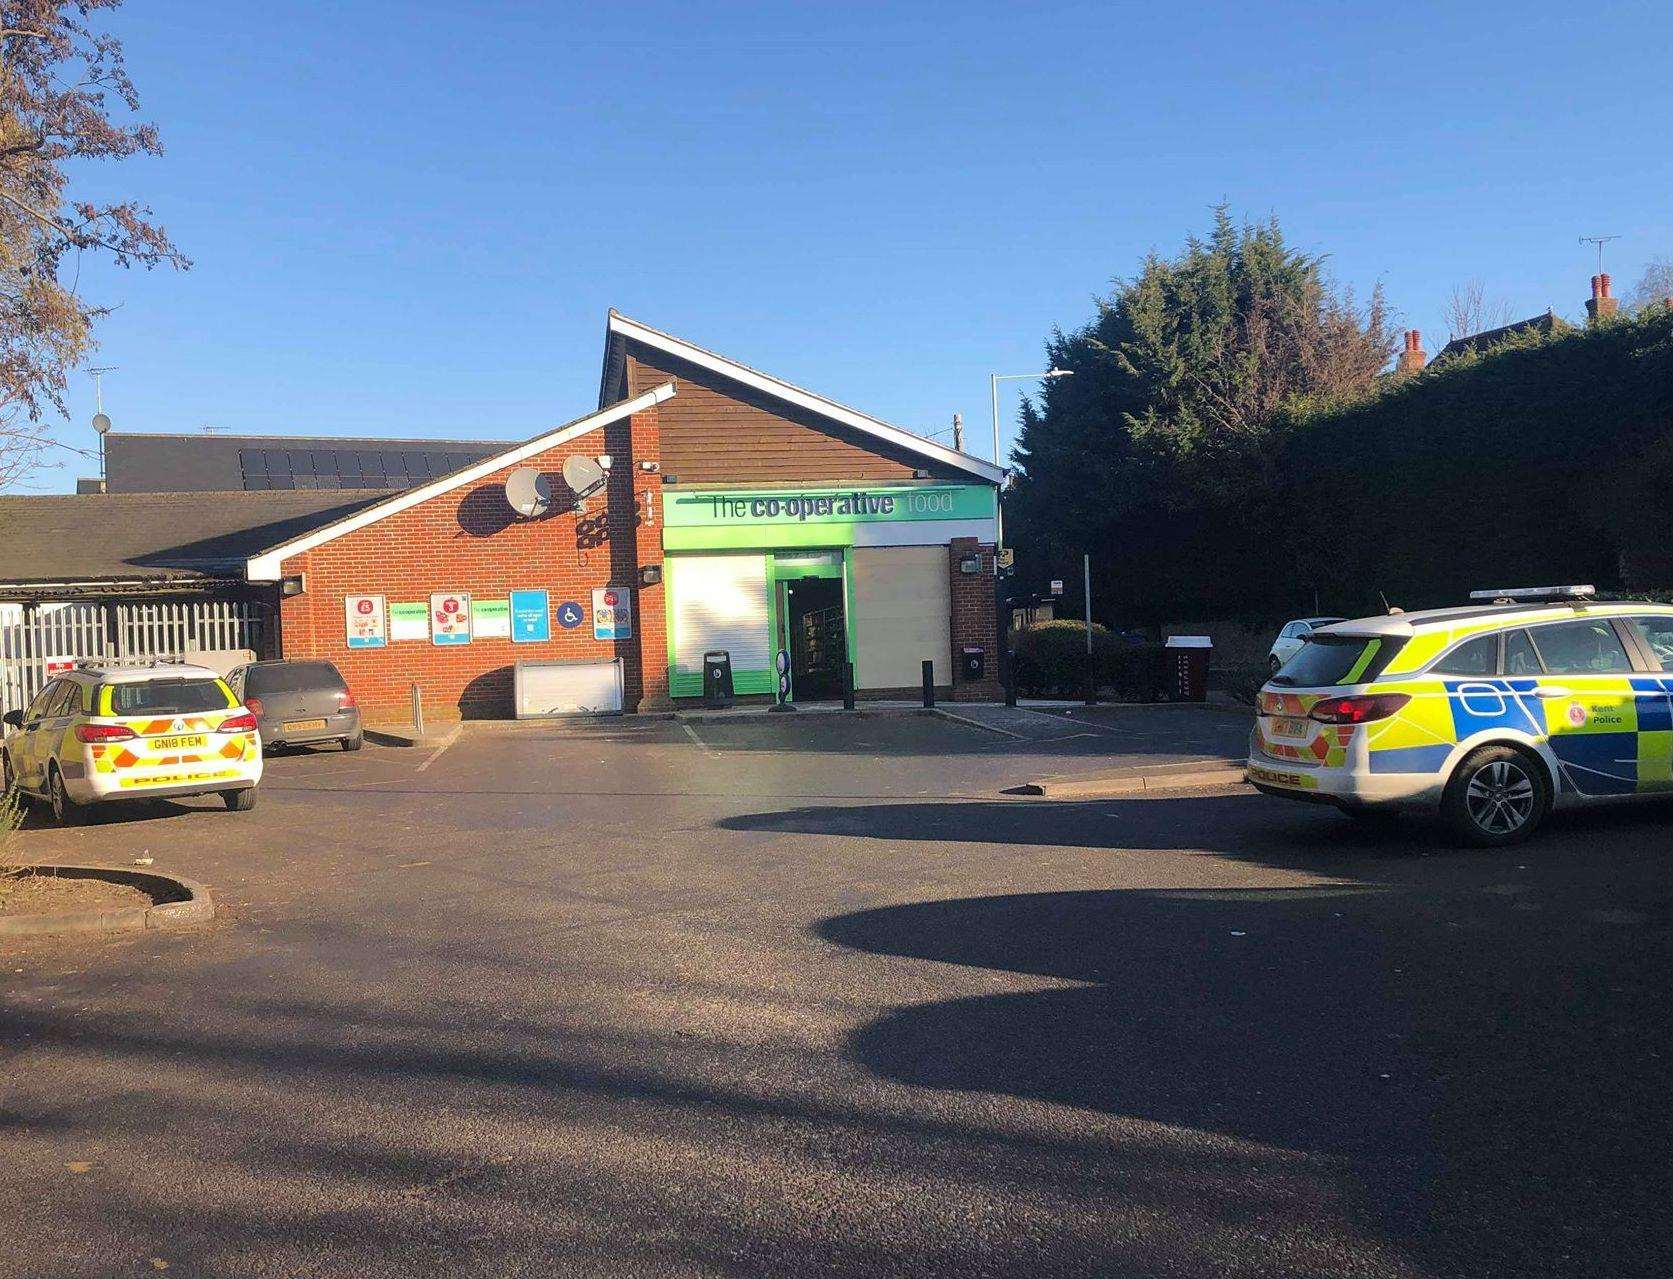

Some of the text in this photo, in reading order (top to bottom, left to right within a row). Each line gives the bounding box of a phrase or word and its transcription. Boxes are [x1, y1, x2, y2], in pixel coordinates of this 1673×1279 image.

[713, 490, 953, 521] The co-operative food
[1591, 705, 1614, 713] Kent
[1593, 716, 1622, 725] Police
[154, 739, 178, 750] GN18
[134, 770, 226, 785] POLICE
[1249, 766, 1301, 786] POLICE
